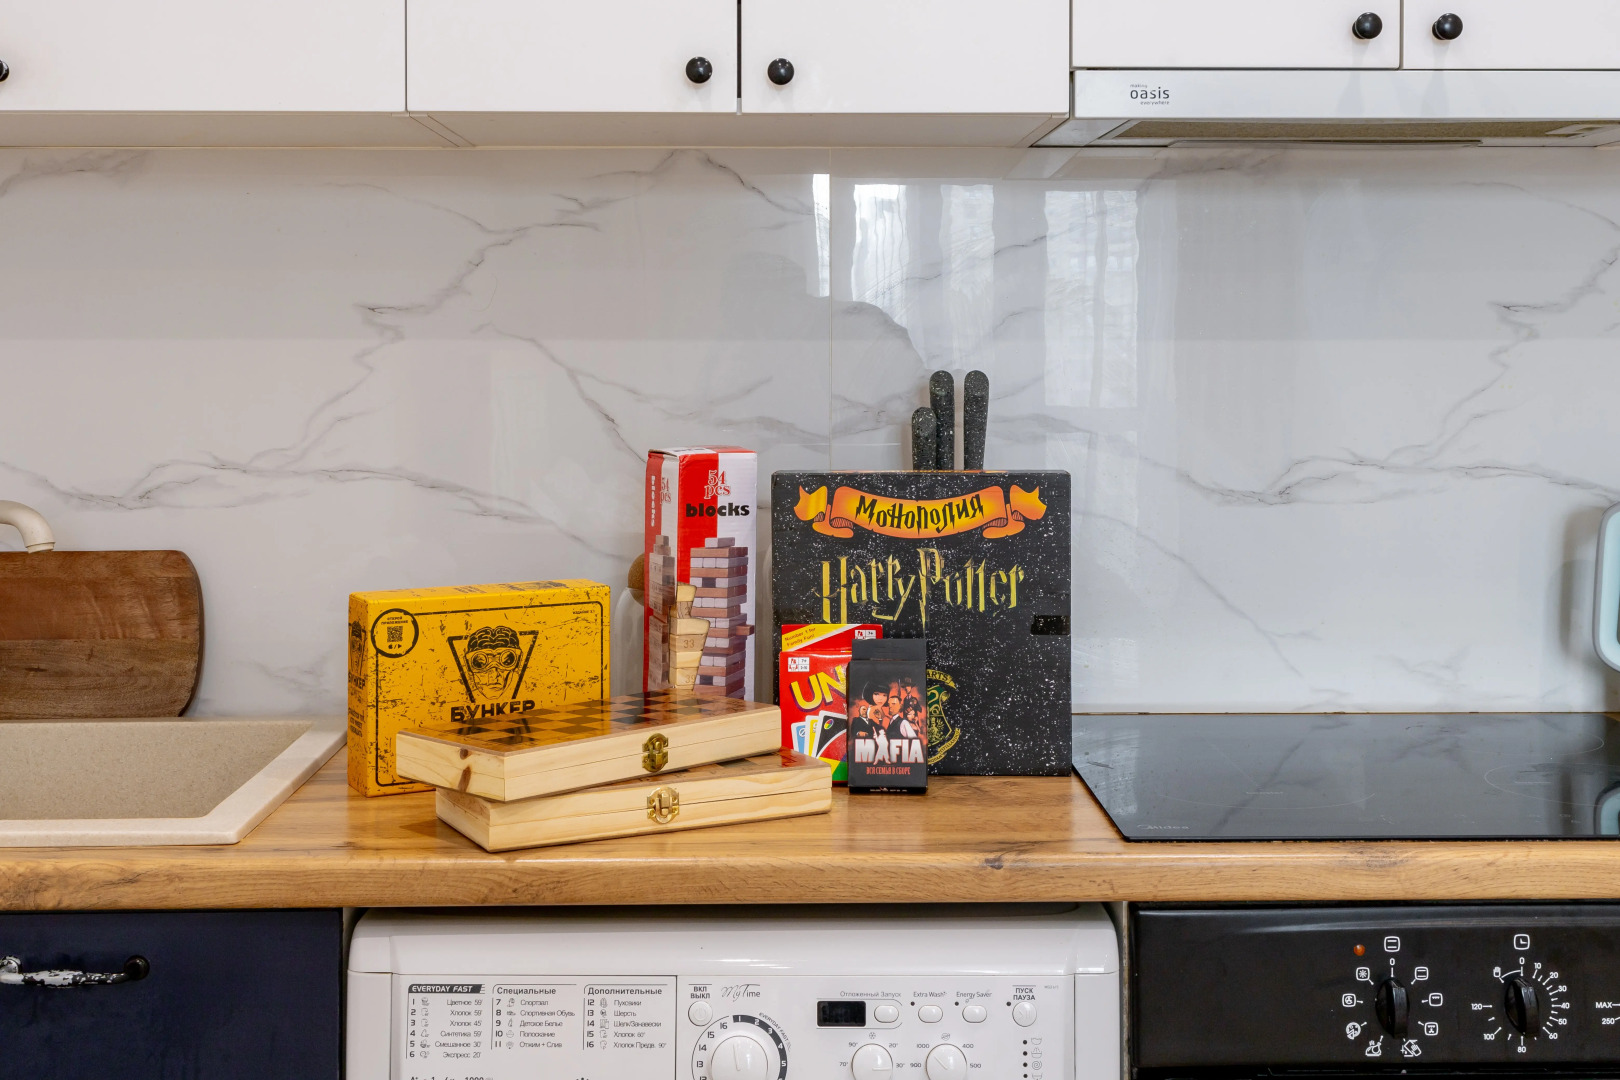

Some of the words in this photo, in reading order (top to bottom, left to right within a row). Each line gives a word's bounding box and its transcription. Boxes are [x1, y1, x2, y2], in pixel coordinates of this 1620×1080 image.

[1130, 86, 1170, 99] oasis
[708, 470, 727, 485] 54
[704, 484, 731, 499] pcs
[685, 503, 750, 518] blocks
[811, 554, 916, 624] Harry
[916, 548, 1025, 637] Potter
[784, 632, 804, 641] Number
[683, 639, 695, 649] 33
[786, 638, 803, 647] Family
[790, 665, 846, 710] UN
[451, 700, 535, 722] БУНКЕР
[855, 726, 924, 765] MAFIA
[866, 767, 875, 775] ВСЯ
[876, 767, 891, 775] СЕМЬЯ
[1389, 958, 1395, 966] 0
[1519, 957, 1525, 965] 0
[1549, 971, 1559, 979] 20
[497, 987, 556, 995] Специальные
[588, 987, 662, 995] Дополнительные
[956, 991, 975, 999] Energy
[613, 999, 642, 1007] Пуховики
[1601, 1017, 1615, 1025] 250
[759, 1012, 781, 1031] EVERYDAY
[779, 1028, 789, 1042] FAST
[1548, 1032, 1558, 1040] 60
